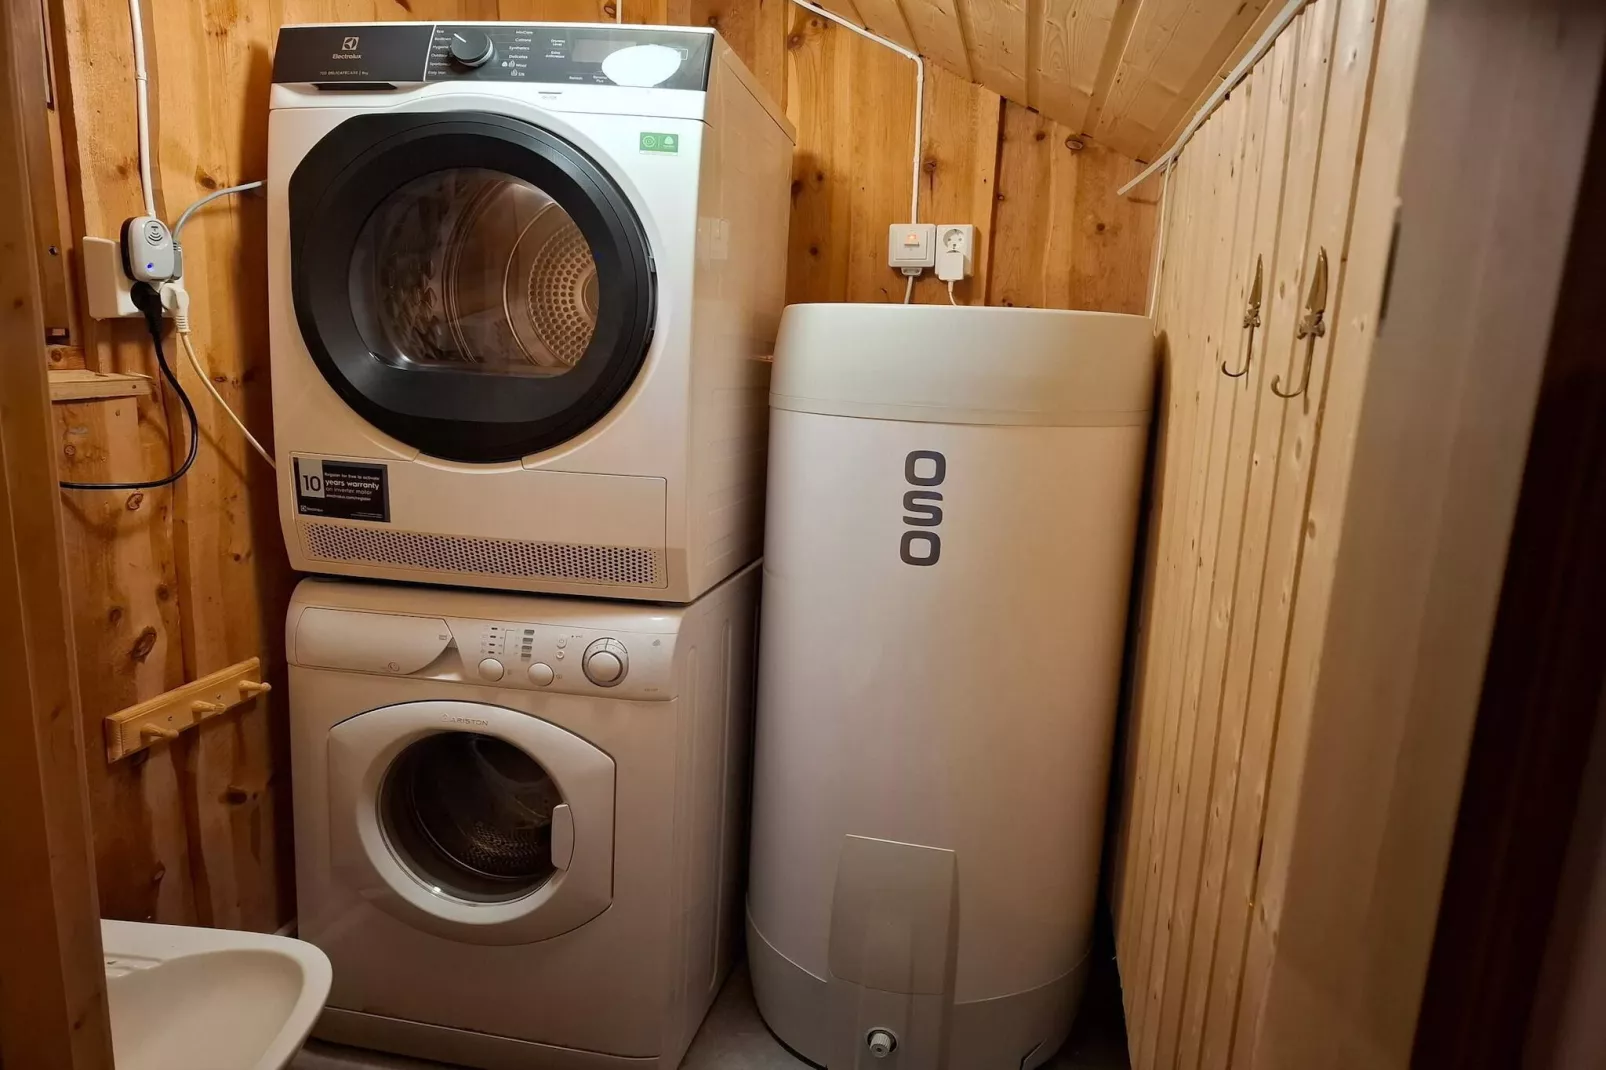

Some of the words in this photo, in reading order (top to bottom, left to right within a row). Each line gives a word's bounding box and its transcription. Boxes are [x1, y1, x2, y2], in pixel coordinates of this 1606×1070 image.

[303, 475, 320, 491] 10
[325, 479, 345, 487] years
[347, 481, 380, 490] warranty
[900, 450, 946, 566] OSO
[450, 717, 488, 726] ARISTON
